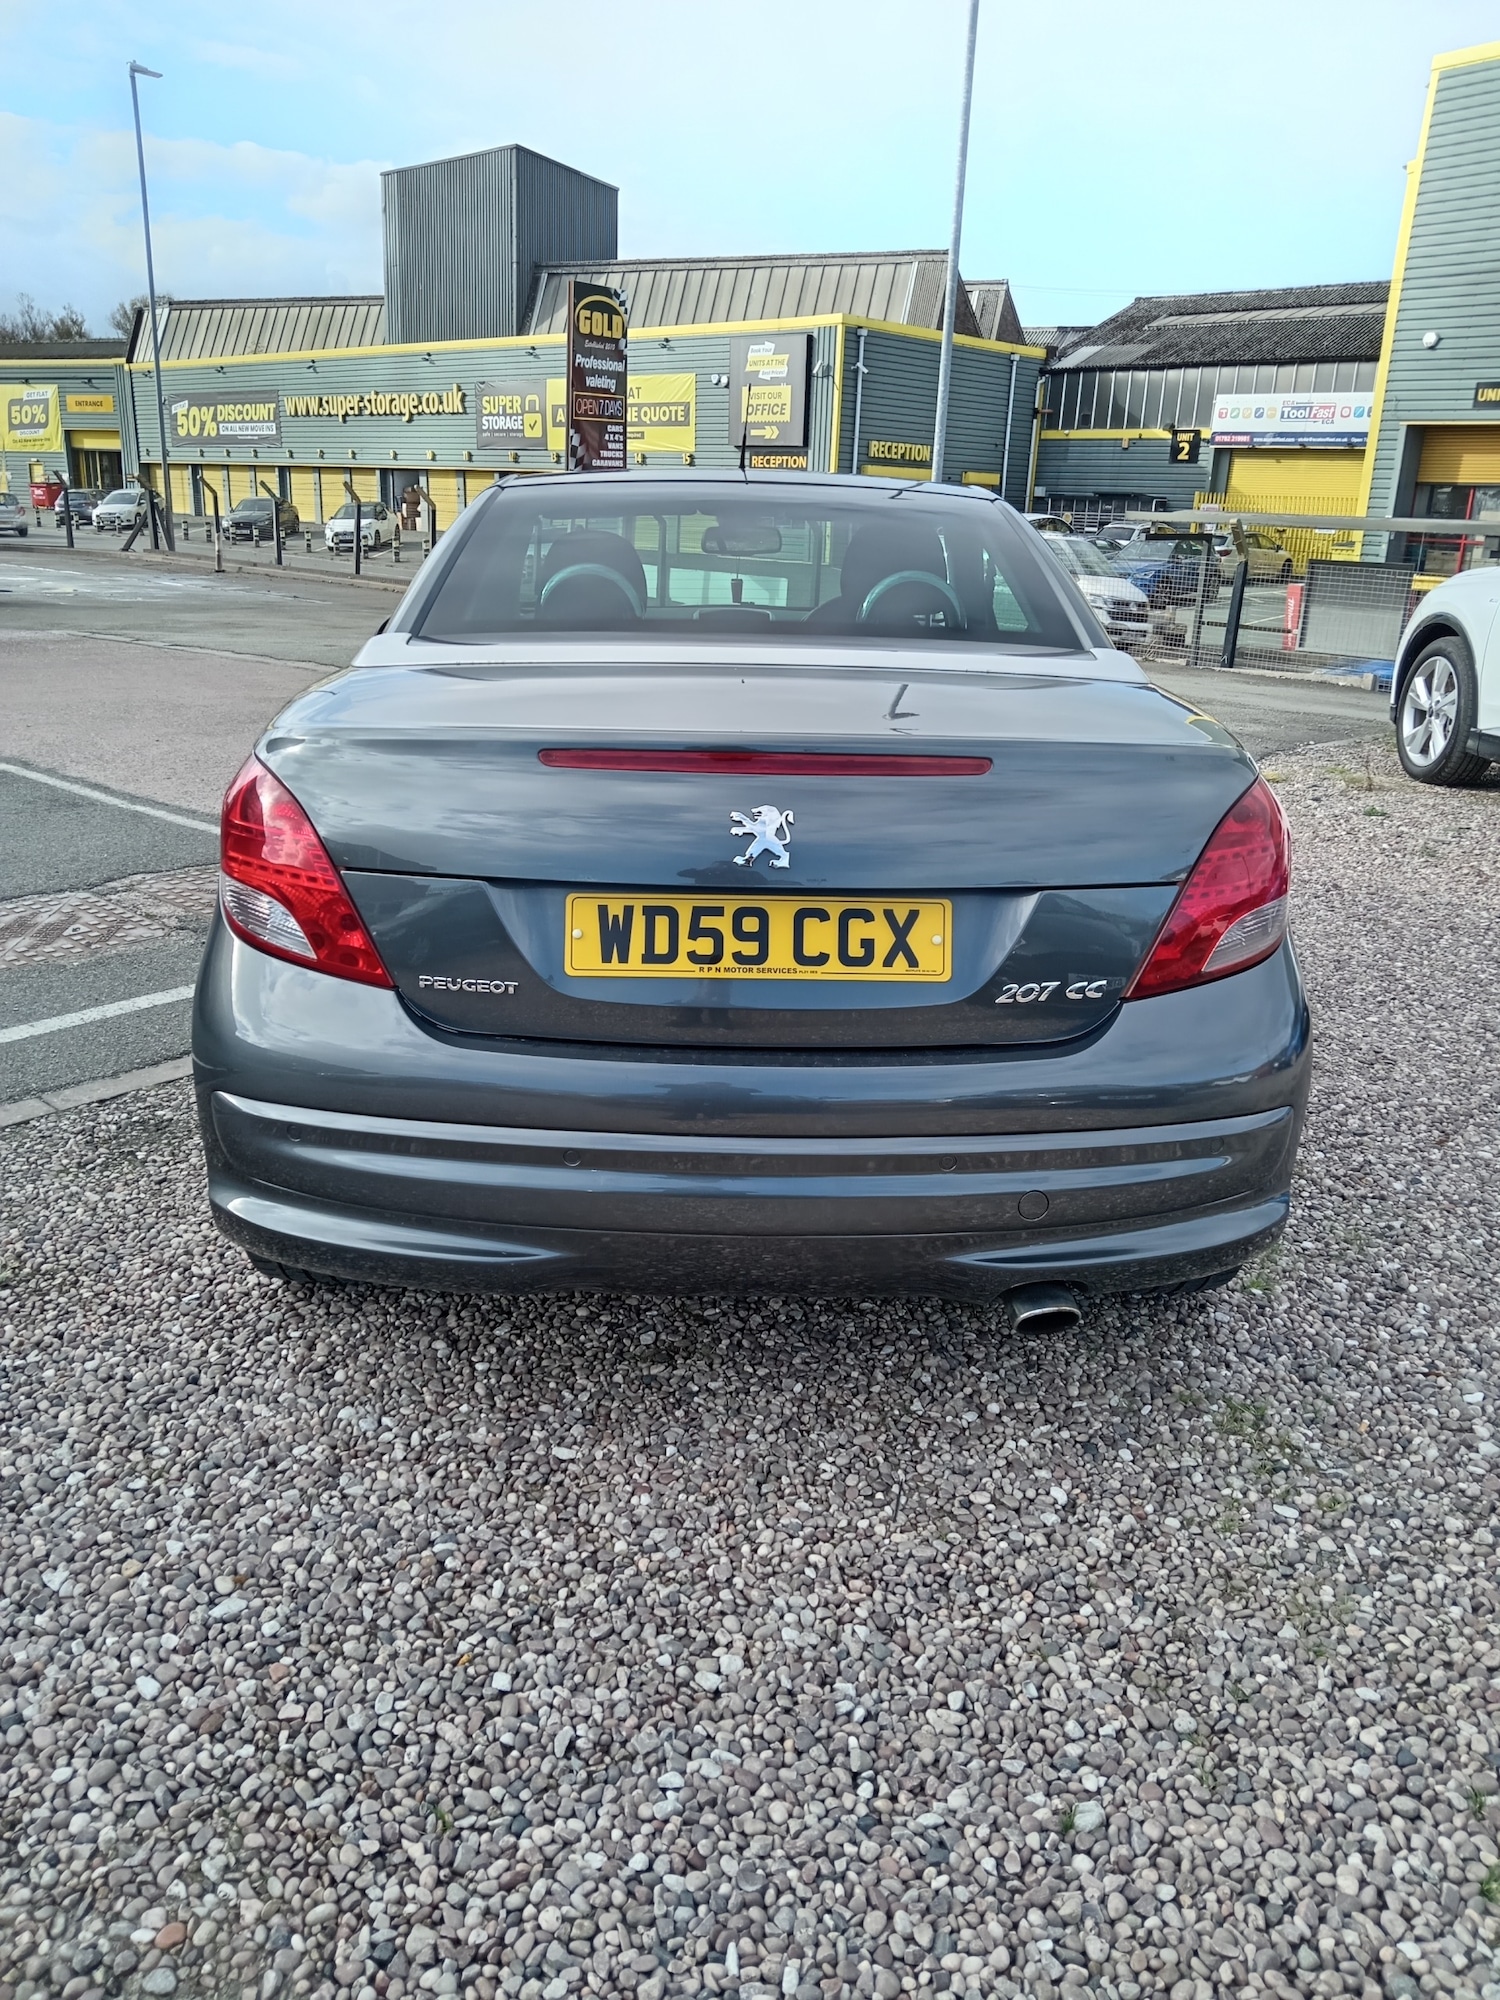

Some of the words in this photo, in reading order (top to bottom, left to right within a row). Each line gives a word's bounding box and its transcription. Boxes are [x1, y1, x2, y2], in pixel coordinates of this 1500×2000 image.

[579, 309, 623, 339] GOLD
[575, 353, 626, 372] Professional
[749, 359, 766, 367] UNITS
[775, 358, 786, 366] THE
[585, 374, 617, 393] valeting
[74, 400, 104, 408] ENTRANCE
[283, 383, 465, 423] www.super-storage.co.uk
[749, 392, 767, 400] VISIT
[767, 391, 783, 400] OUR
[217, 403, 276, 421] DISCOUNT
[482, 395, 522, 415] SUPER
[576, 398, 599, 415] OPEN
[599, 400, 604, 415] 7
[605, 400, 623, 416] DAYS
[746, 402, 787, 416] OFFICE
[10, 404, 47, 425] 50%
[177, 406, 218, 437] 50%
[482, 415, 523, 430] STORAGE
[640, 405, 685, 424] QUOTE
[250, 425, 266, 433] MOVE
[265, 425, 274, 433] INS
[607, 424, 624, 432] CARS
[1177, 432, 1195, 442] UNIT
[600, 450, 624, 458] TRUCKS
[607, 442, 624, 450] VANS
[868, 440, 932, 462] RECEPTION
[1177, 441, 1190, 460] 2
[592, 459, 624, 468] CARAVANS
[751, 455, 808, 469] RECEPTION
[597, 904, 770, 966] WD59
[793, 907, 920, 968] CGX
[723, 966, 754, 974] MOTOR
[756, 967, 798, 975] SERVICES
[418, 975, 519, 995] PEUGEOT
[994, 981, 1062, 1004] 207
[1065, 979, 1108, 1000] CC
